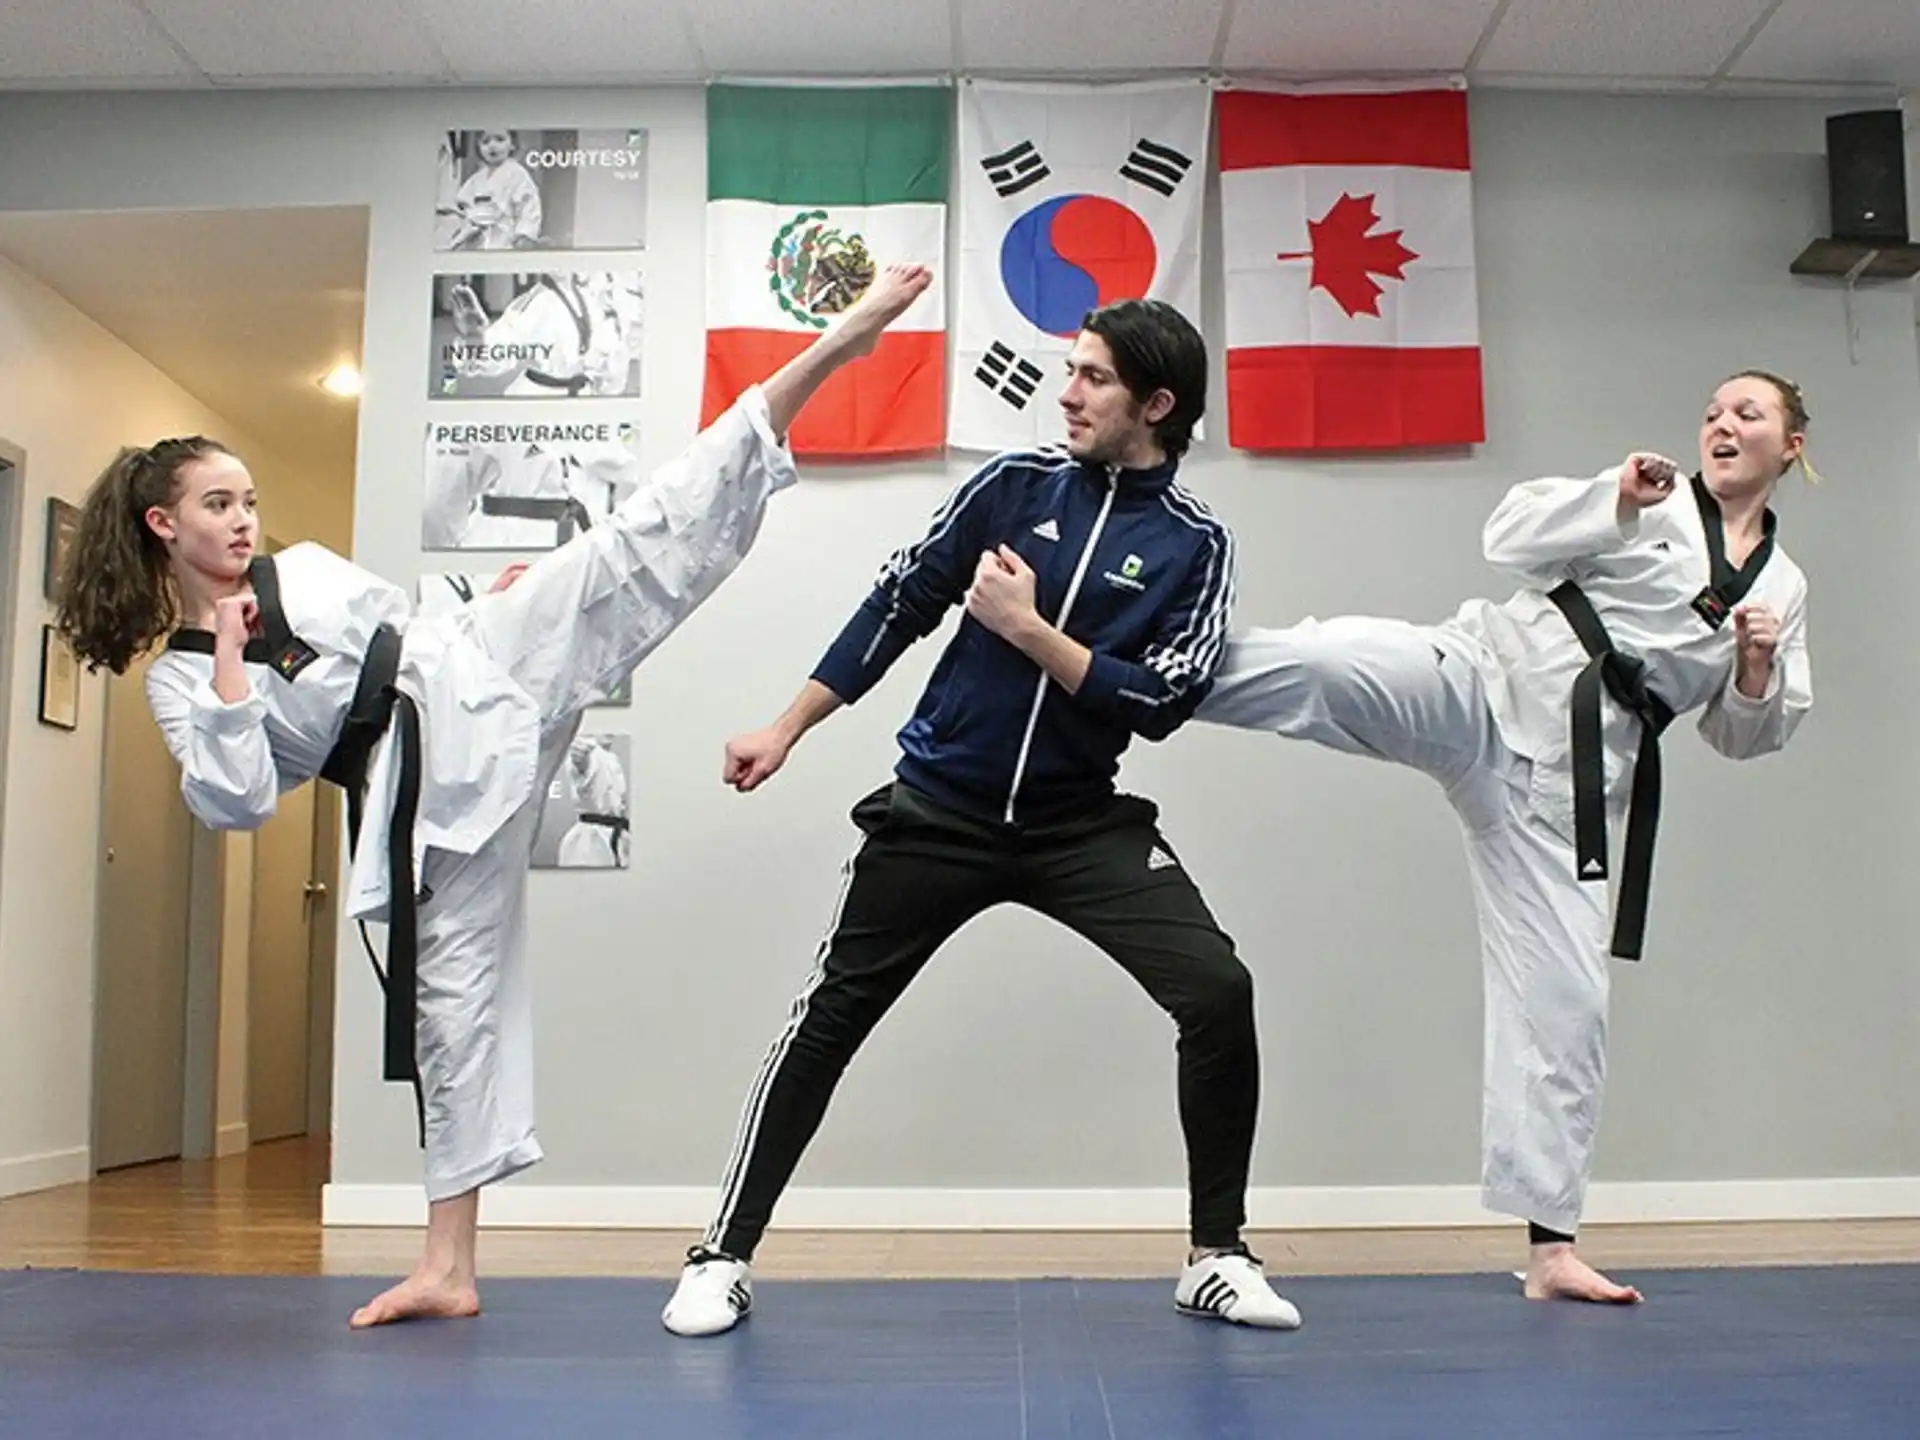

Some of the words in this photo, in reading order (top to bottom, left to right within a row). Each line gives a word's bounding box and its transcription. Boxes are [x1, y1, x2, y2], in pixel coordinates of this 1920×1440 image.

[525, 148, 642, 168] COURTESY
[443, 344, 554, 361] INTEGRITY
[436, 423, 609, 443] PERSEVERANCE
